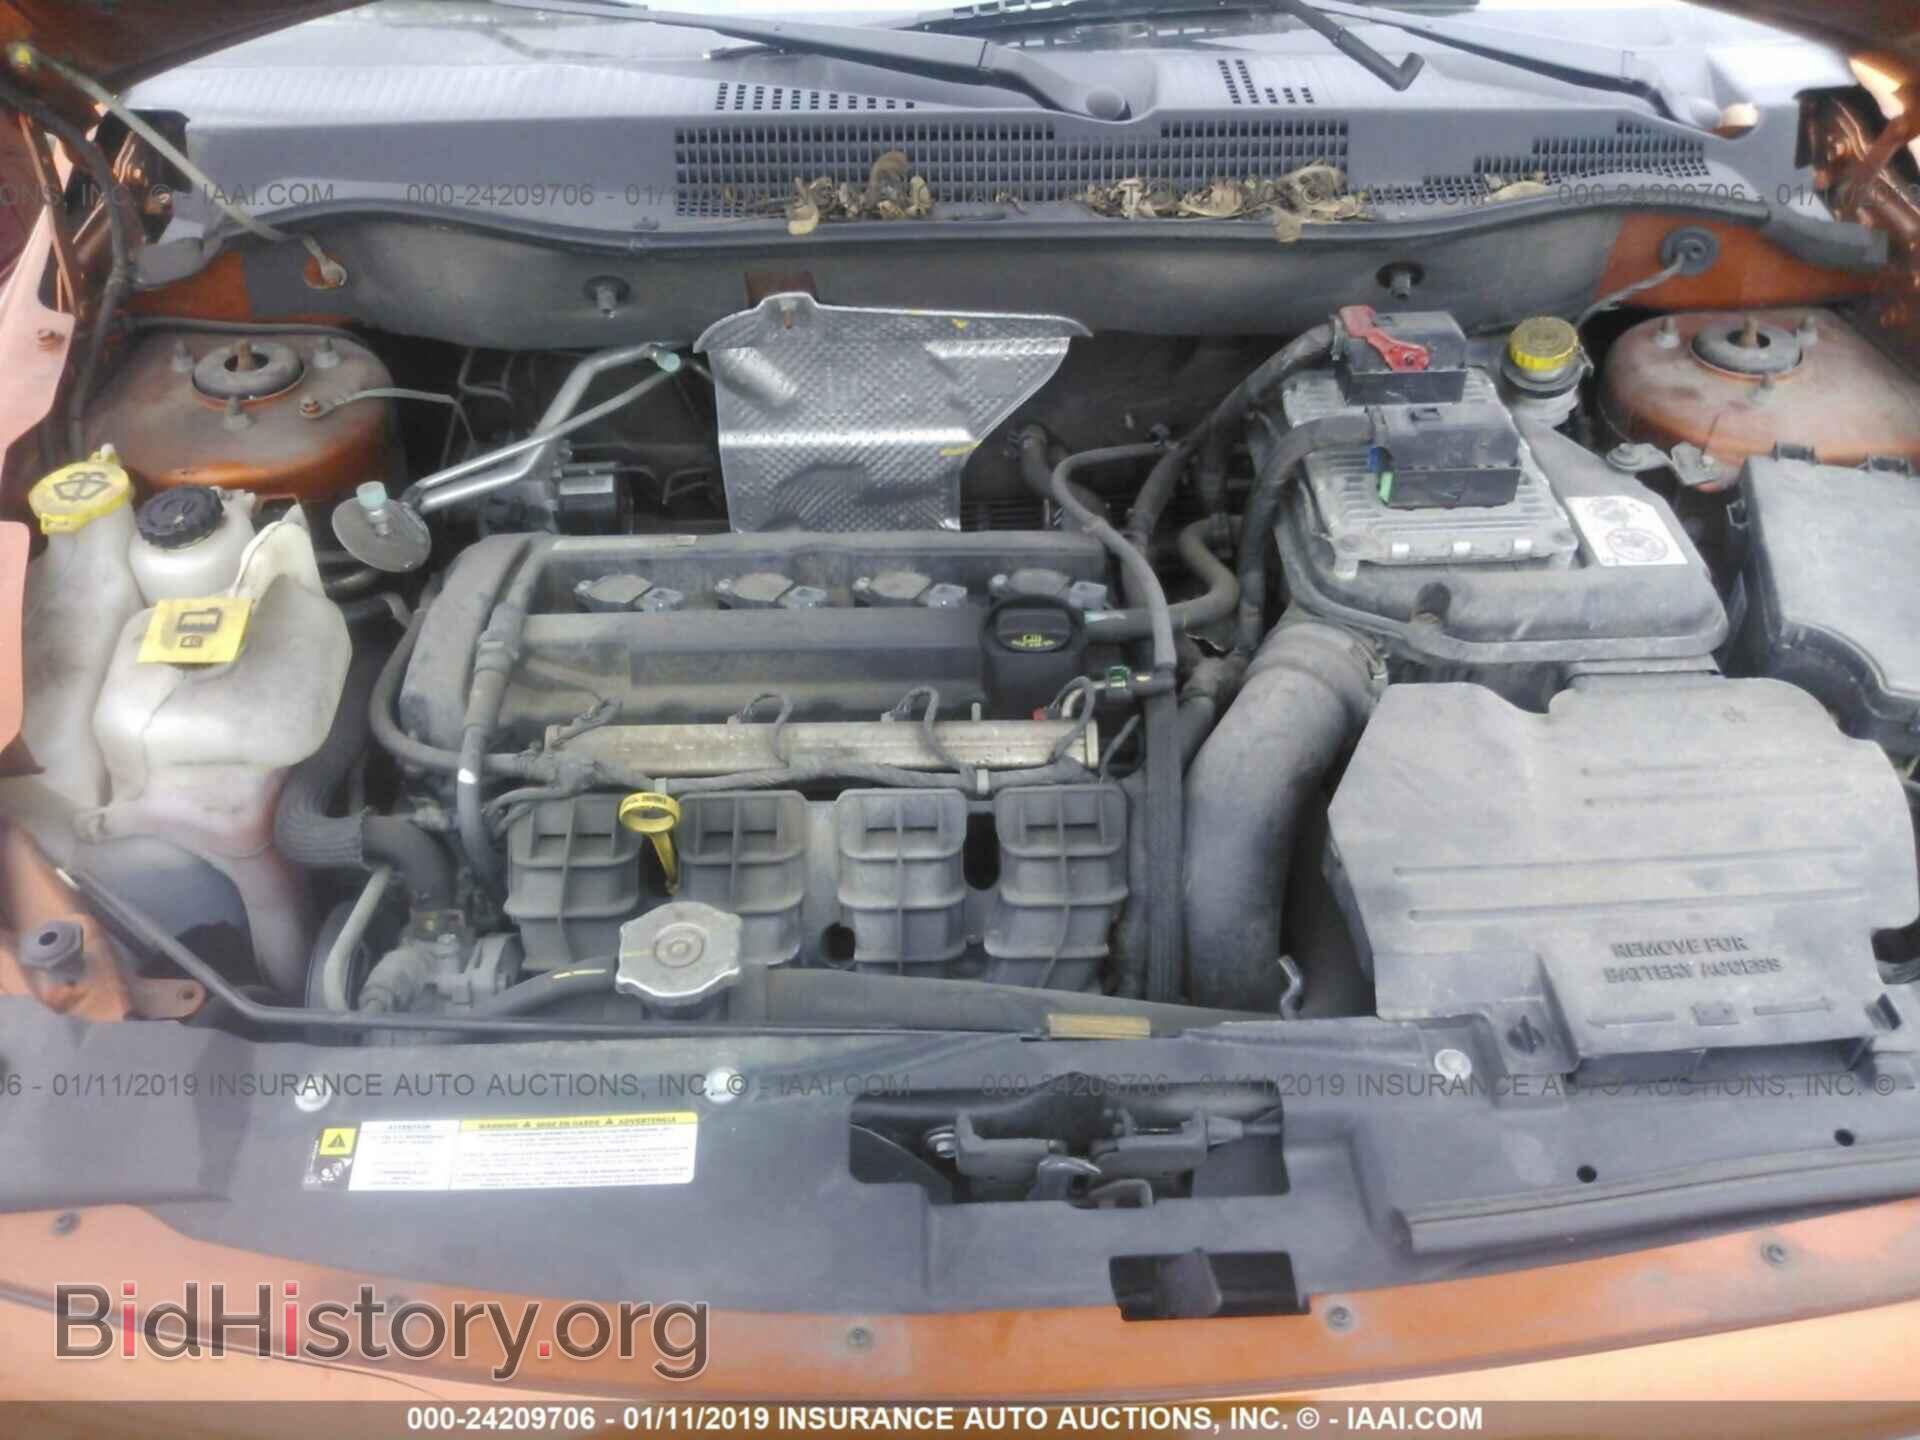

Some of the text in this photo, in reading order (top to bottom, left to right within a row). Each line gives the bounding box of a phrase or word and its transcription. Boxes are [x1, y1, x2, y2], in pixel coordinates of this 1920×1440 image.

[1610, 935, 1749, 959] REMOVE FOR
[1602, 957, 1785, 983] BATTERY ACCESS
